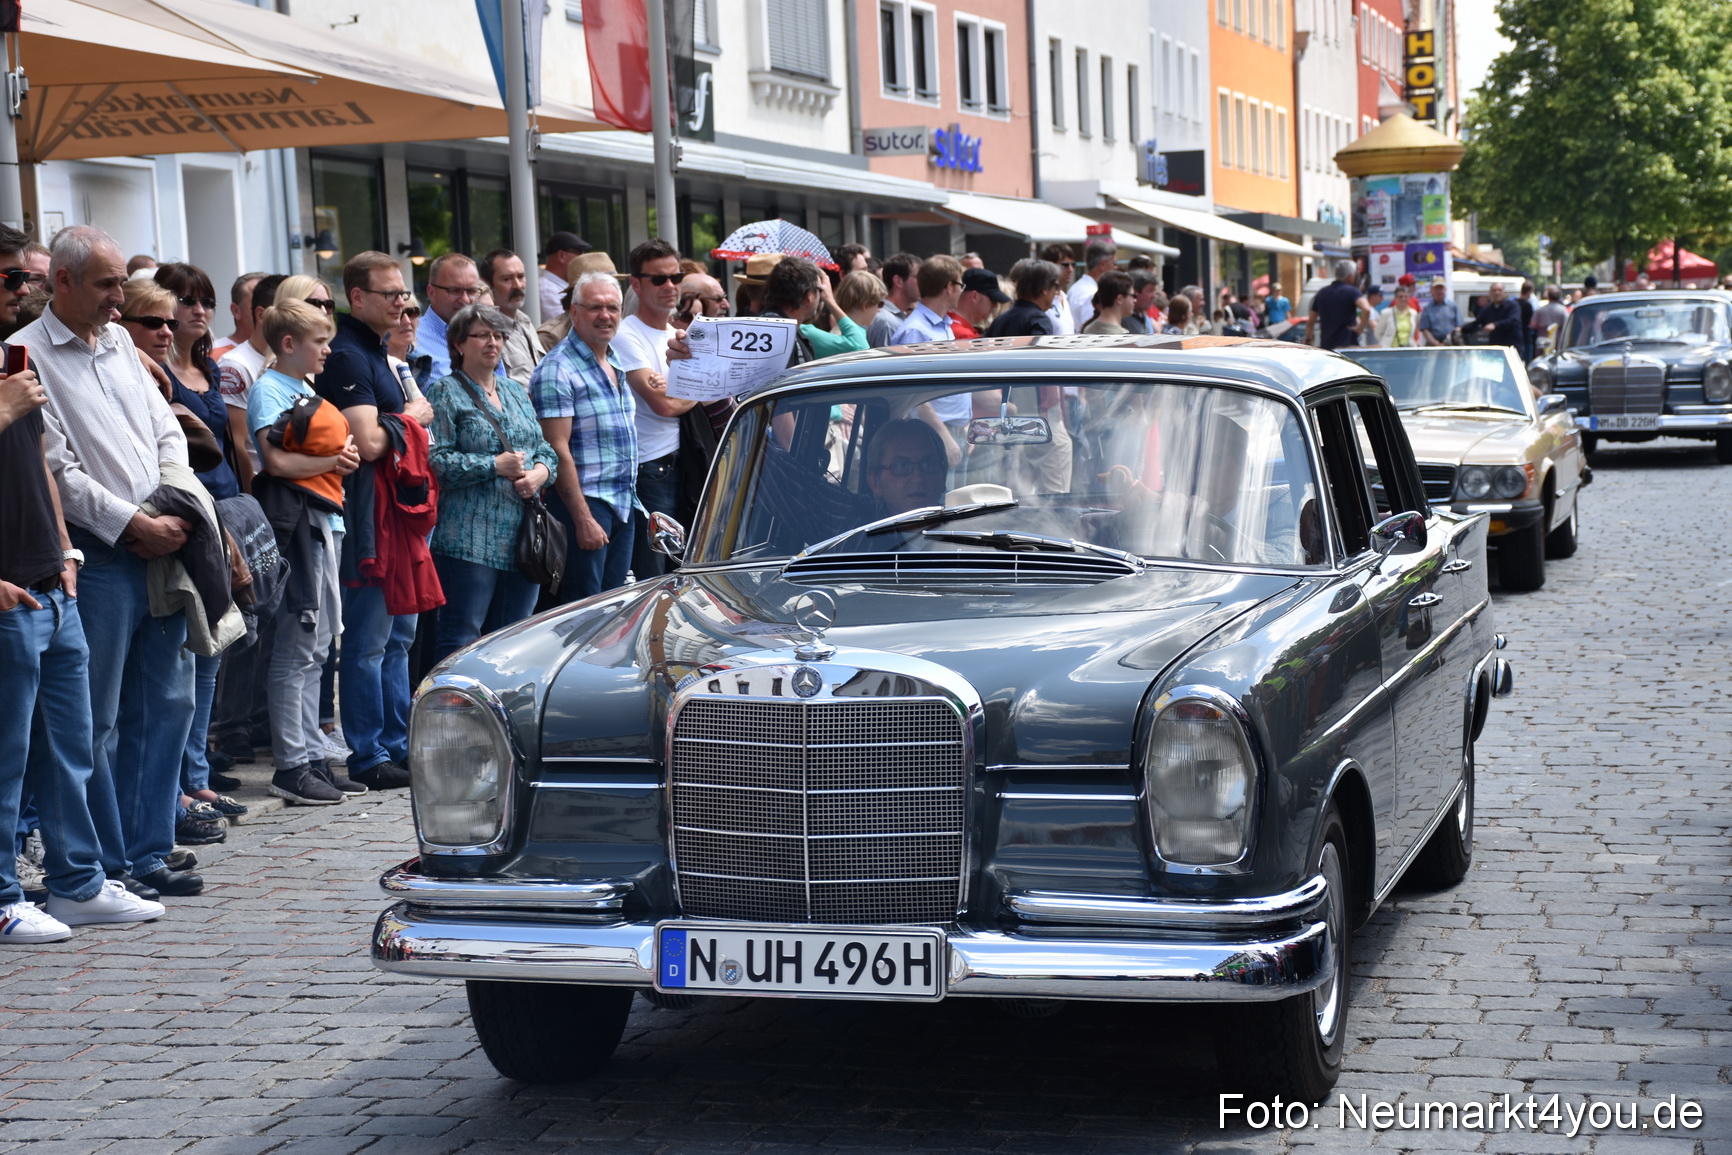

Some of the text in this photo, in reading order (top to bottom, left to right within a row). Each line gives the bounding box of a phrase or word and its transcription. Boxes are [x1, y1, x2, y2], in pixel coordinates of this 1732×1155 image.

[730, 330, 773, 353] 223
[1616, 417, 1629, 428] DB
[669, 964, 678, 977] D
[690, 938, 717, 981] N
[746, 939, 802, 983] UH
[814, 941, 931, 986] 496H
